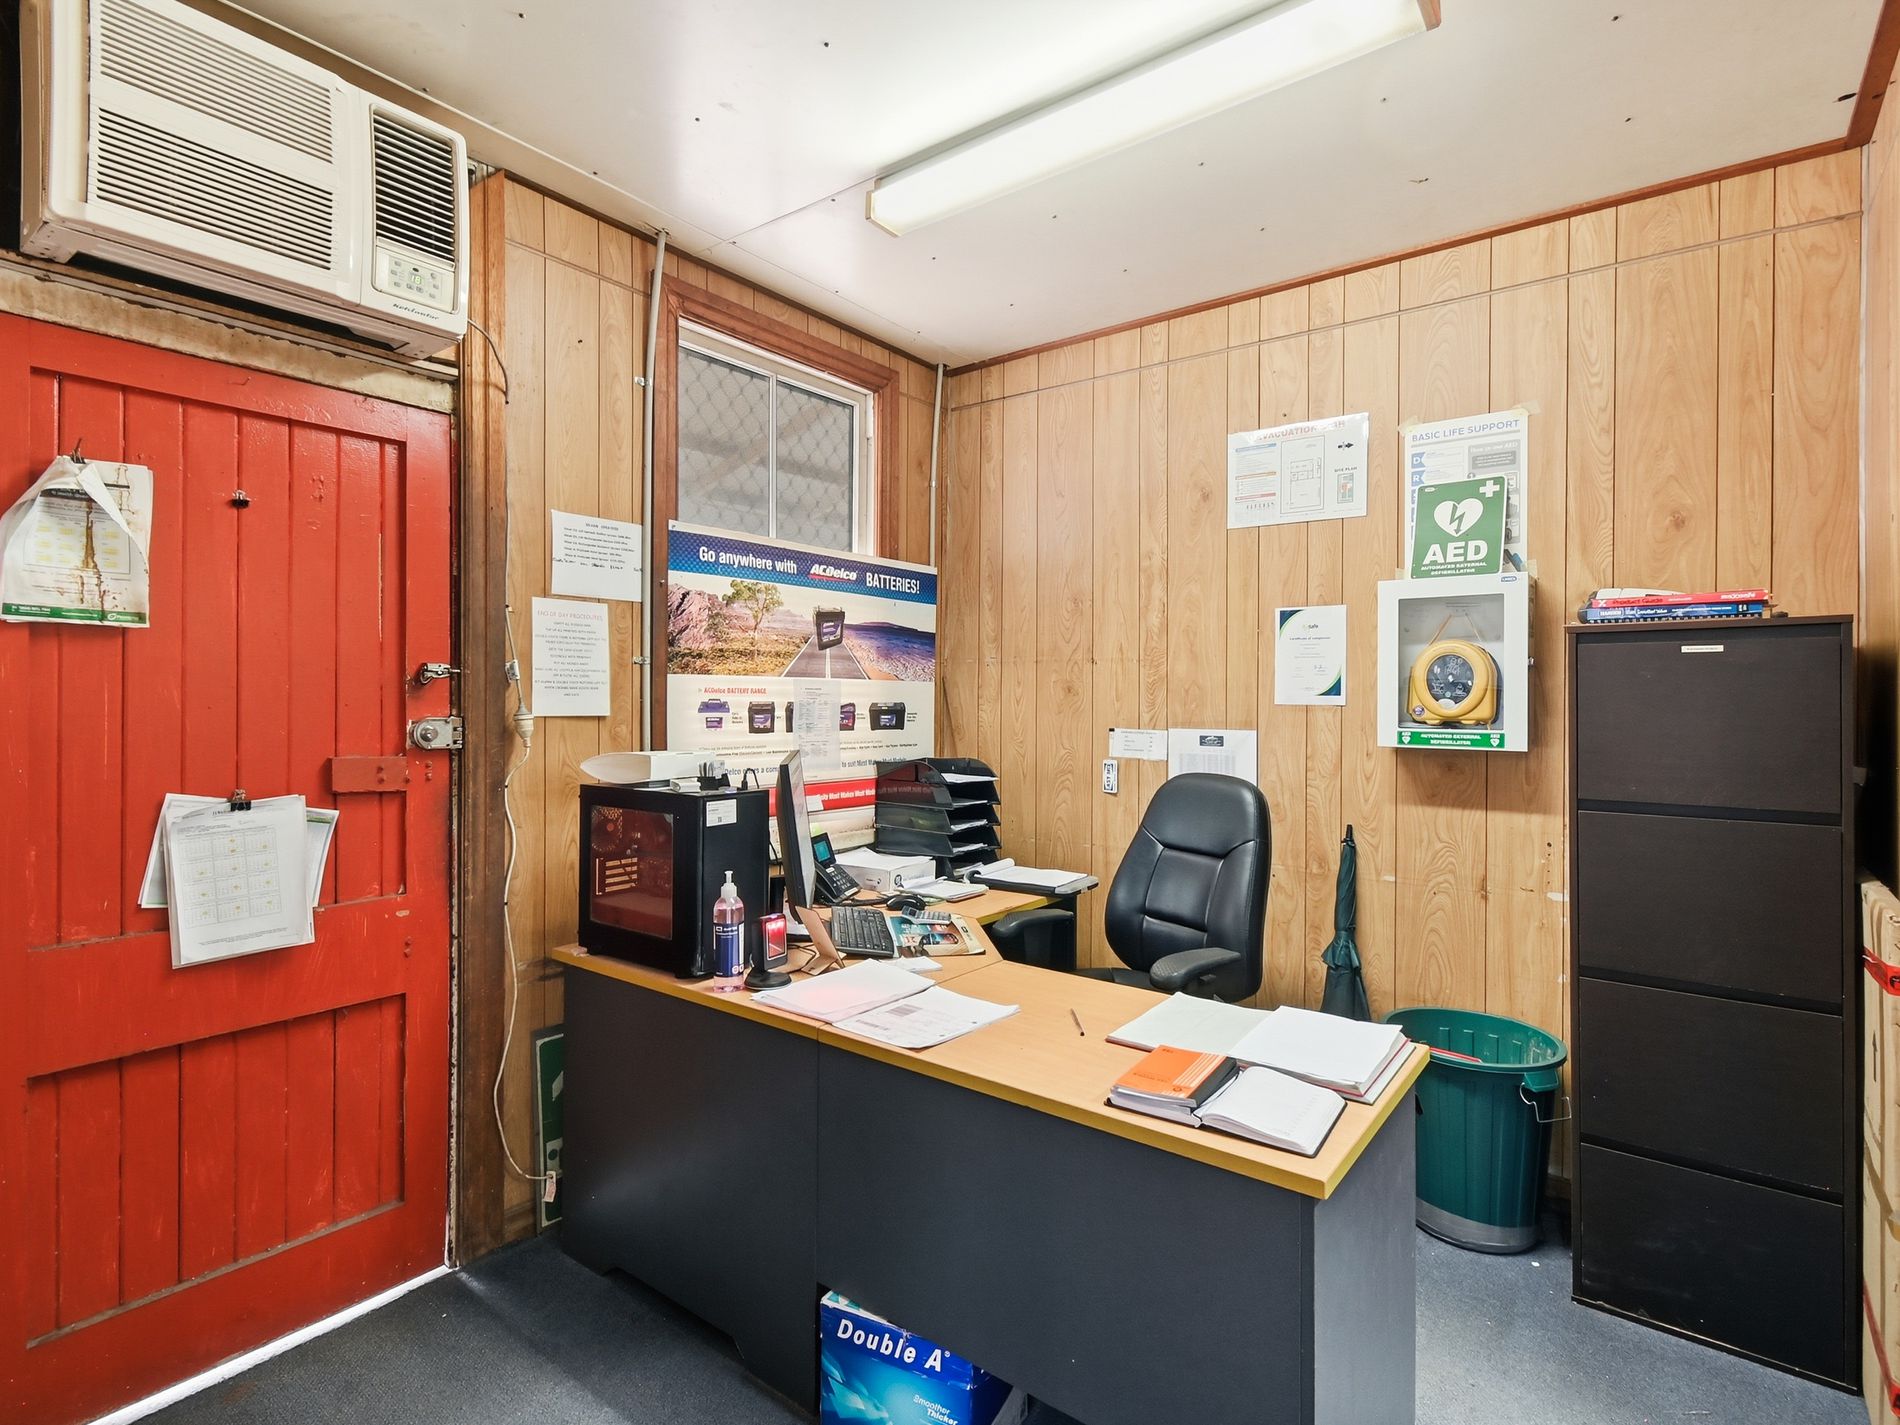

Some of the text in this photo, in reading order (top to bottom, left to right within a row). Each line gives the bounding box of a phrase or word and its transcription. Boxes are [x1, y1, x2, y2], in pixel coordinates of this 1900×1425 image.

[1258, 424, 1317, 440] VACUATION
[1412, 420, 1519, 442] BASIC LIFE SUPPORT
[1422, 540, 1488, 565] AED
[699, 546, 920, 594] Go anywhere with ACDelco BATTERIES!
[1456, 561, 1487, 569] EXTERNAL
[704, 687, 767, 695] ACDelco BATTERY RANGE
[837, 1318, 942, 1372] Double A
[913, 1394, 950, 1415] Smoother
